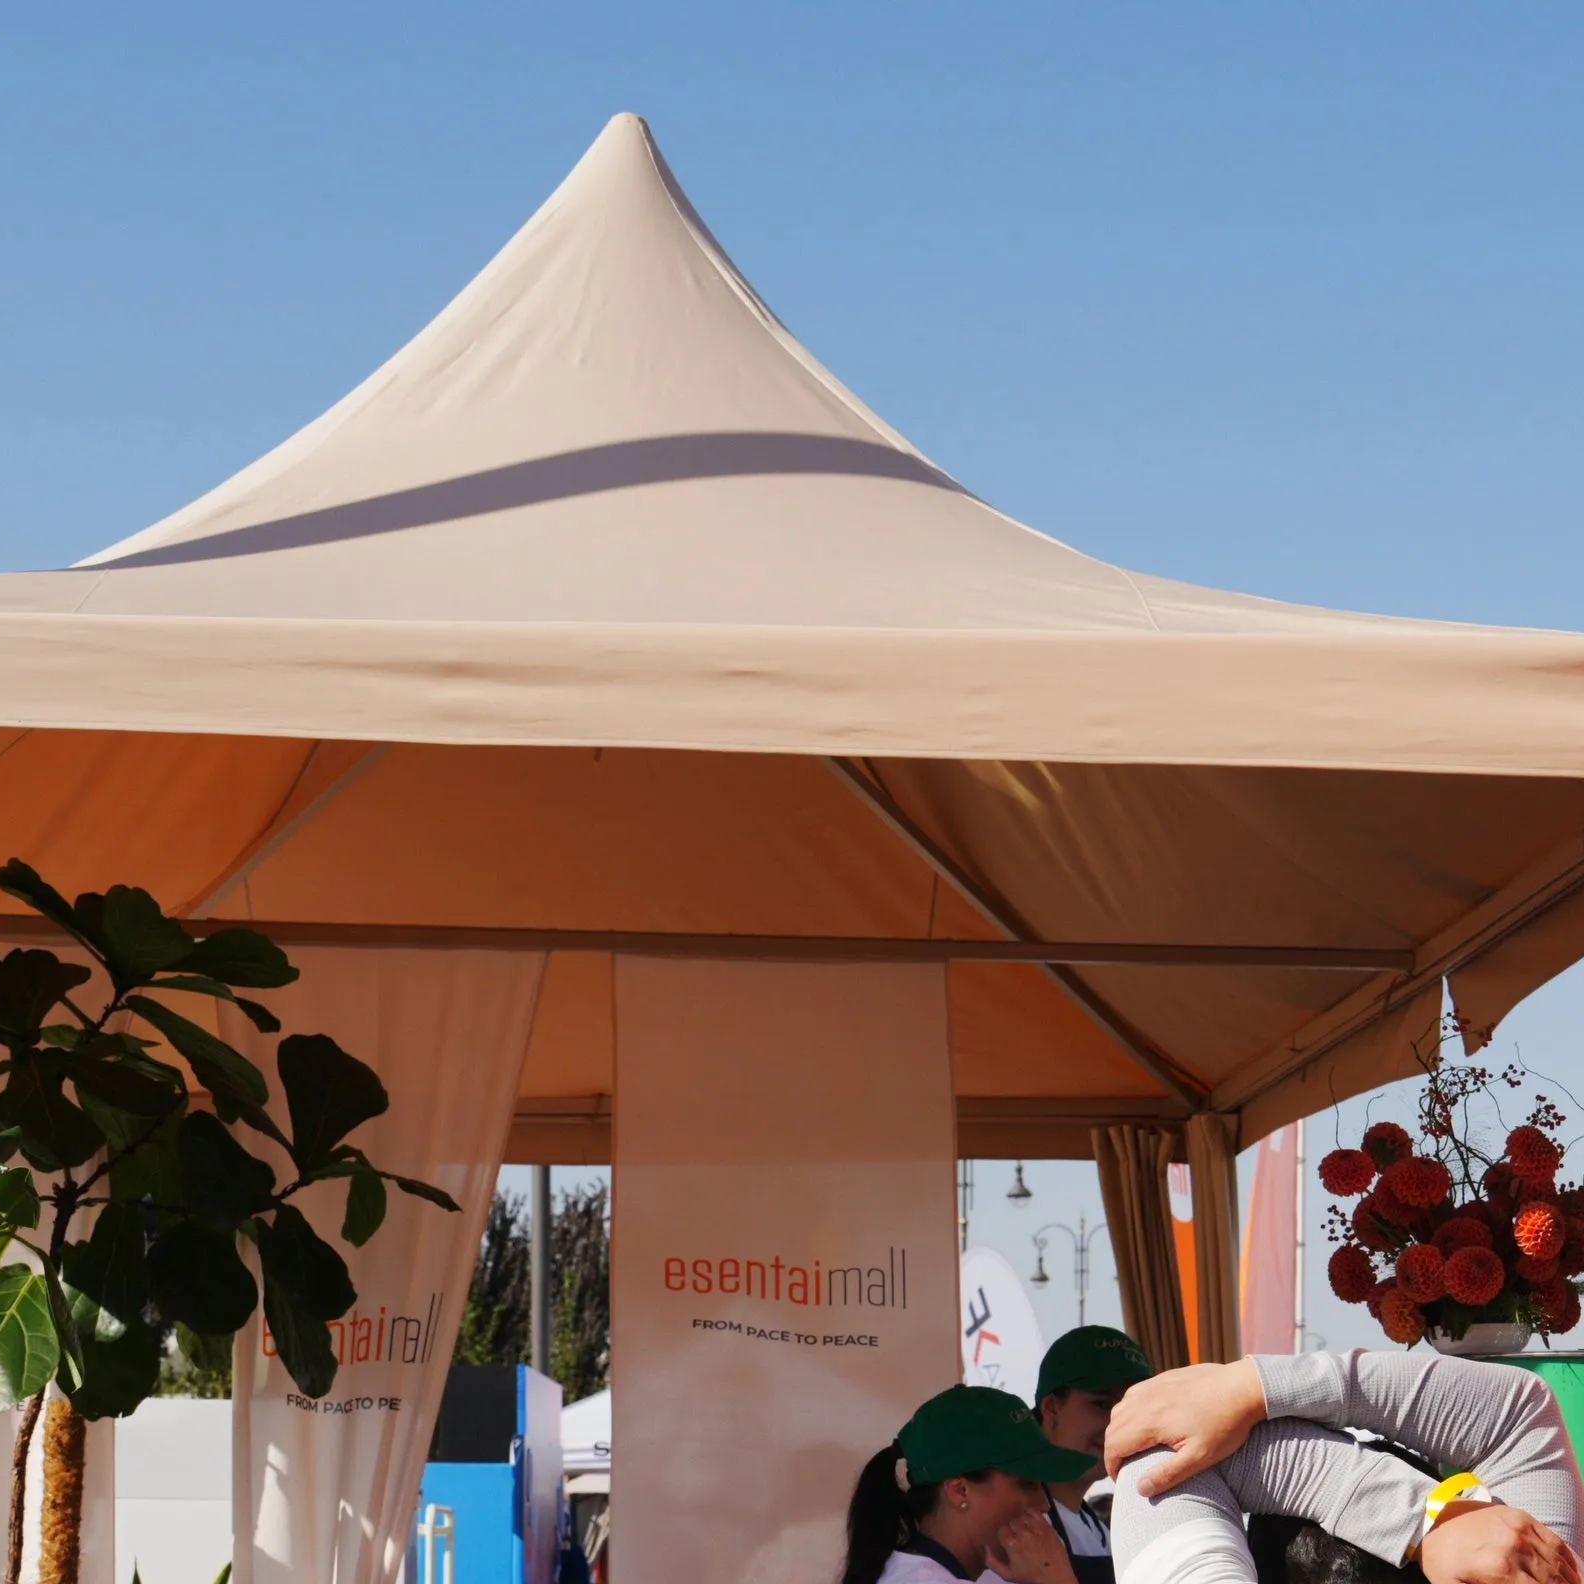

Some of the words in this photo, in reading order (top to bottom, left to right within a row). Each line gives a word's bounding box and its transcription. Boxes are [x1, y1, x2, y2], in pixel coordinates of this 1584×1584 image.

[664, 1246, 907, 1309] esentaimall
[692, 1318, 742, 1334] FROM
[746, 1326, 790, 1343] PACE
[795, 1333, 818, 1345] TO
[822, 1335, 879, 1347] PEACE
[287, 1394, 318, 1413] FROM
